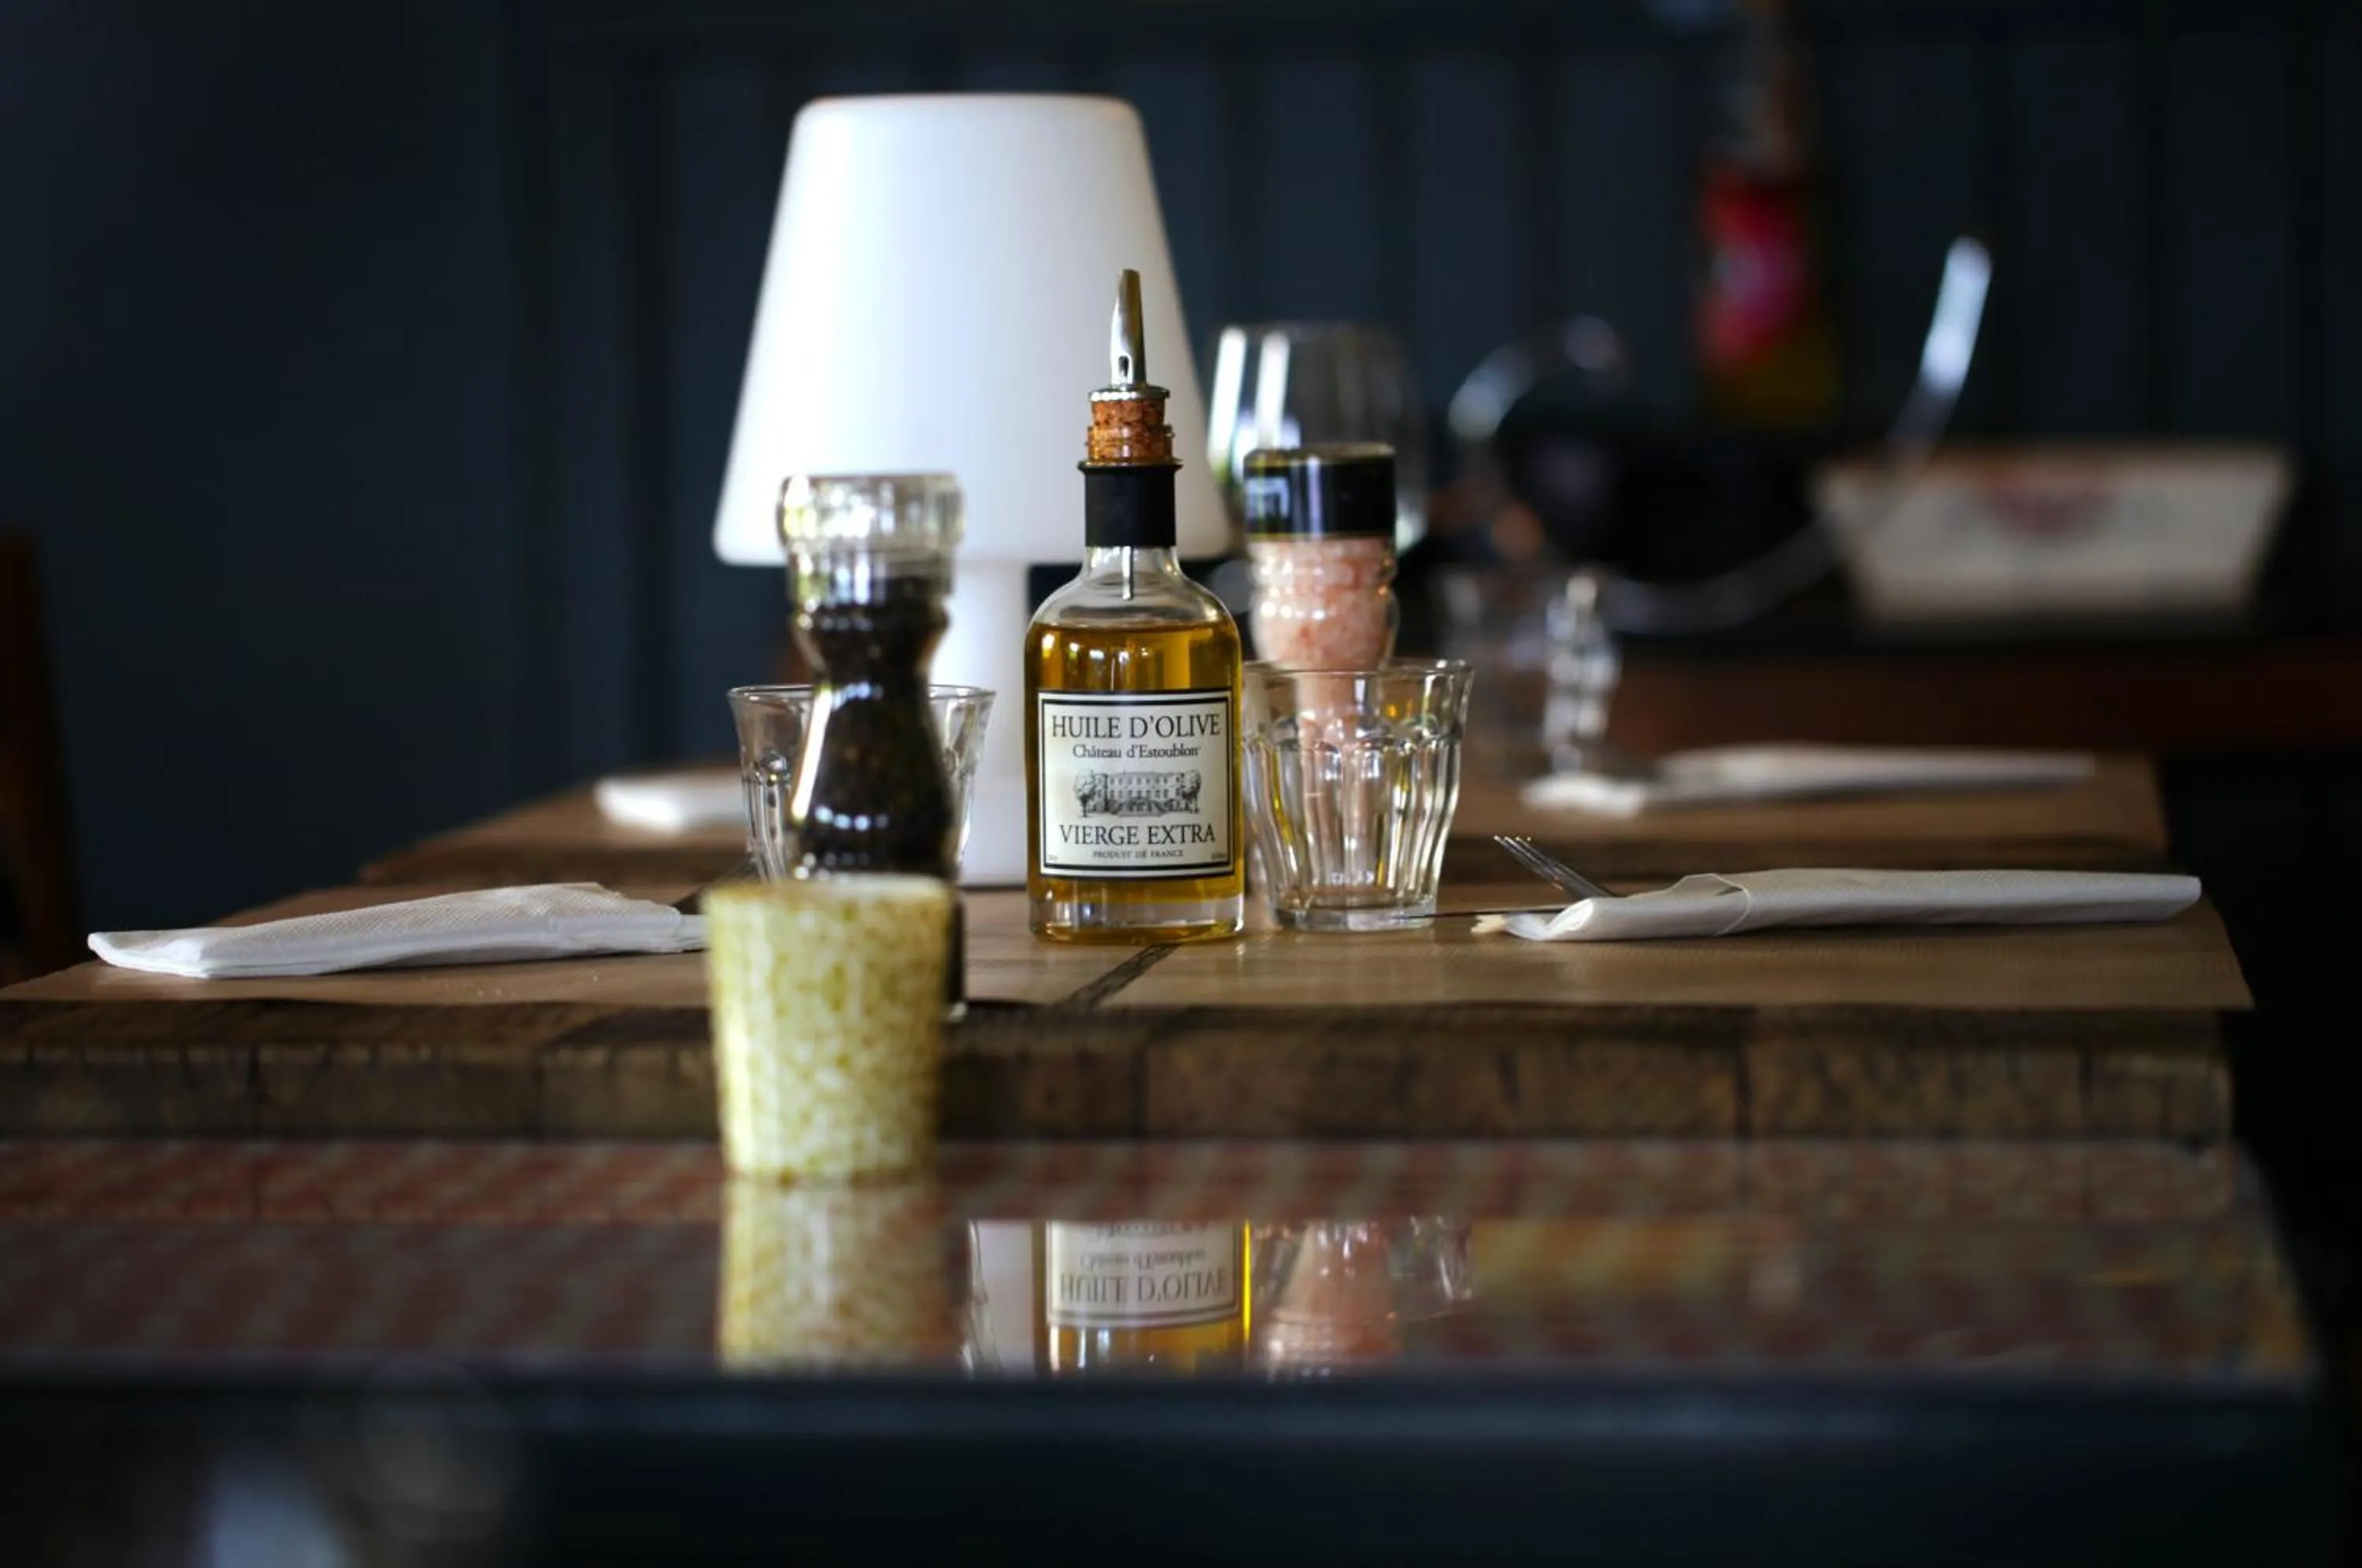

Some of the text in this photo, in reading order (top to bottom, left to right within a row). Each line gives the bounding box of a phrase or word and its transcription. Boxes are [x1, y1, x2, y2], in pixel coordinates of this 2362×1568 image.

[1052, 713, 1221, 738] HUILE D'OLIVE
[1072, 743, 1199, 758] Château d'Estoublon
[1059, 823, 1216, 846] VIERGE EXTRA
[1150, 849, 1184, 858] FRANCE
